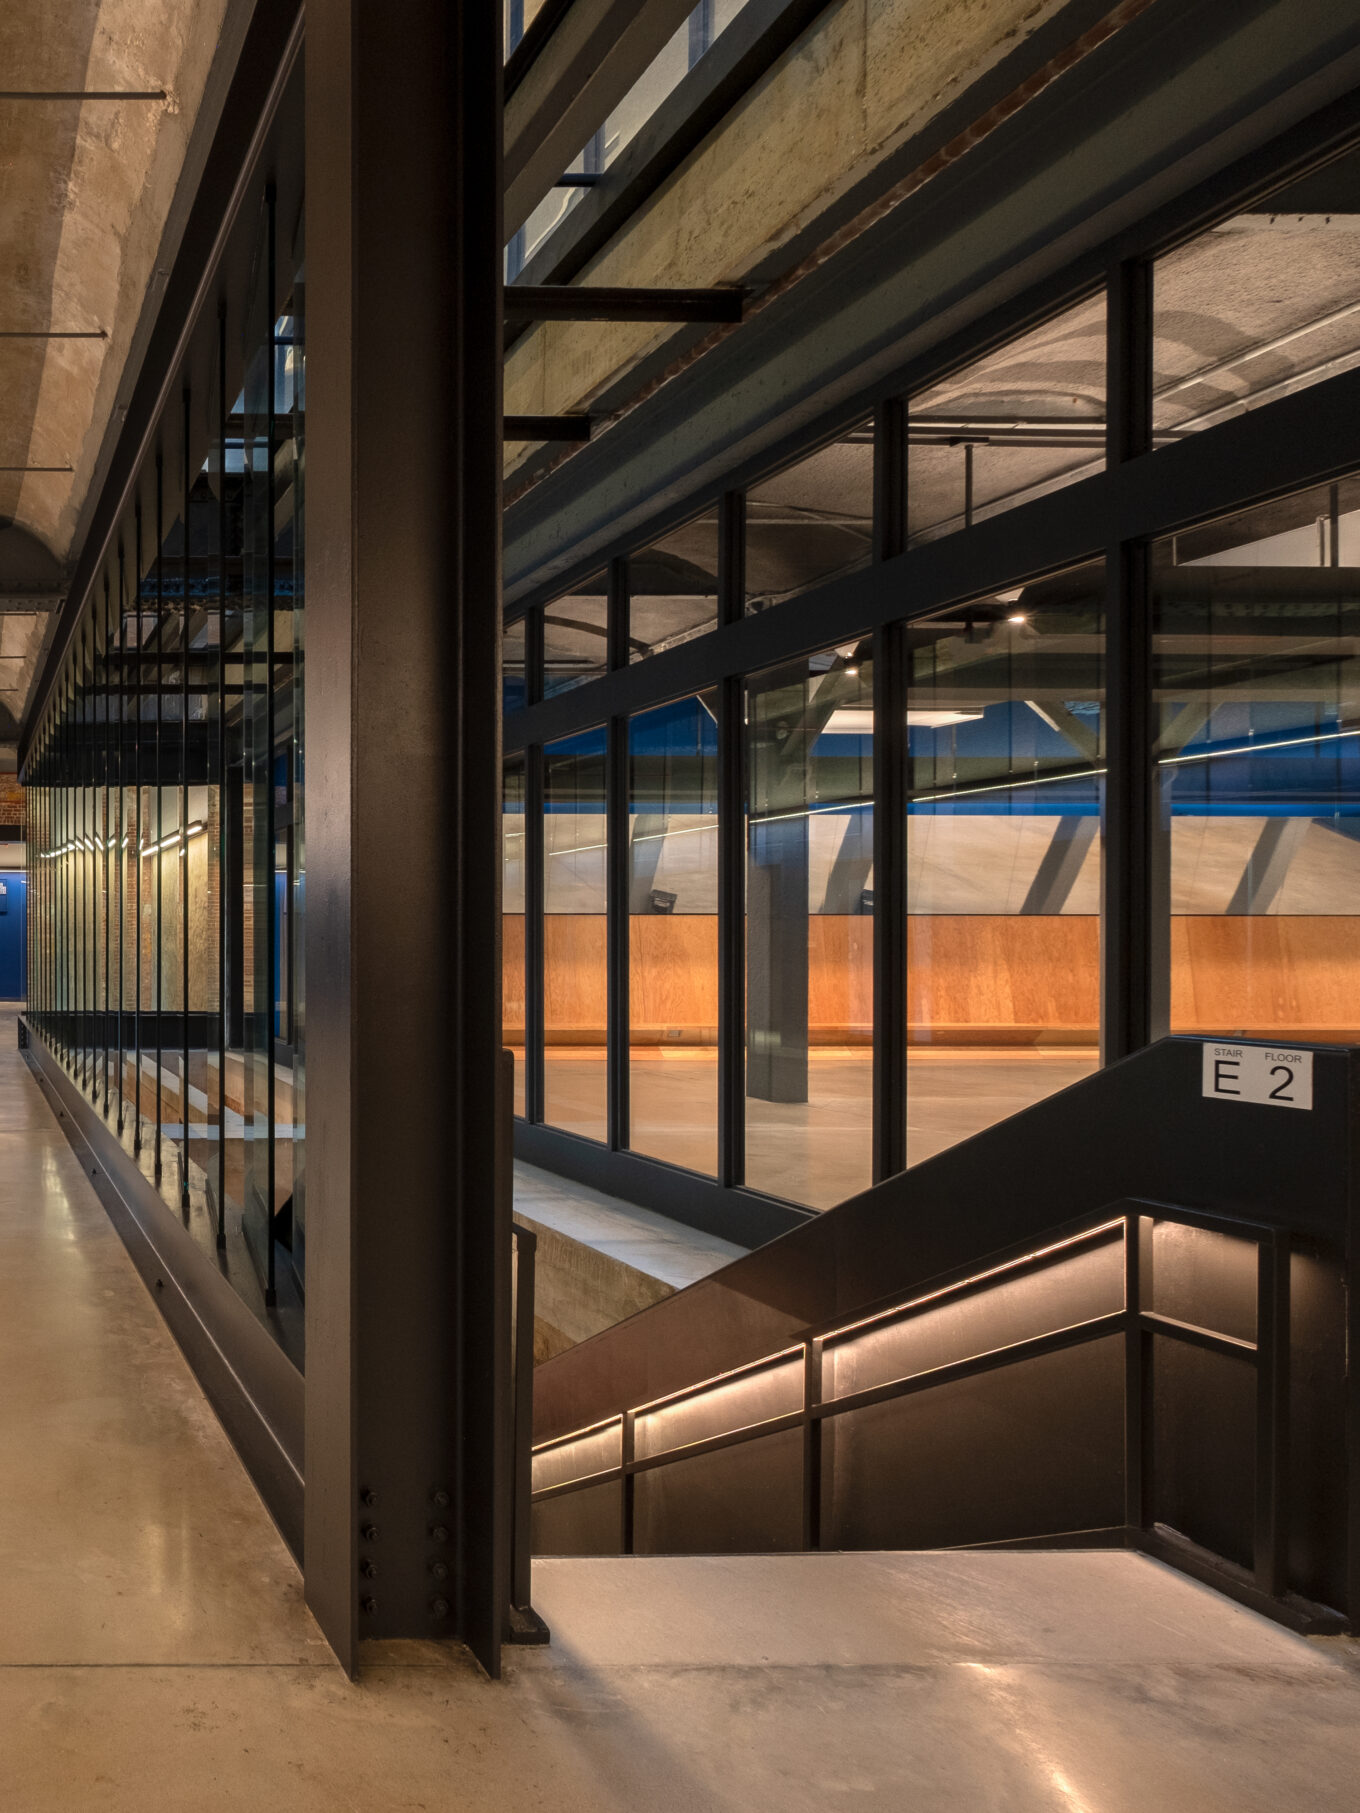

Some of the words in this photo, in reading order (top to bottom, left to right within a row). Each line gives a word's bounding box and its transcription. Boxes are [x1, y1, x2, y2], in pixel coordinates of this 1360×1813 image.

[1214, 1048, 1243, 1058] STAIR
[1265, 1052, 1302, 1063] FLOOR
[1214, 1060, 1240, 1095] E
[1269, 1065, 1294, 1101] 2
